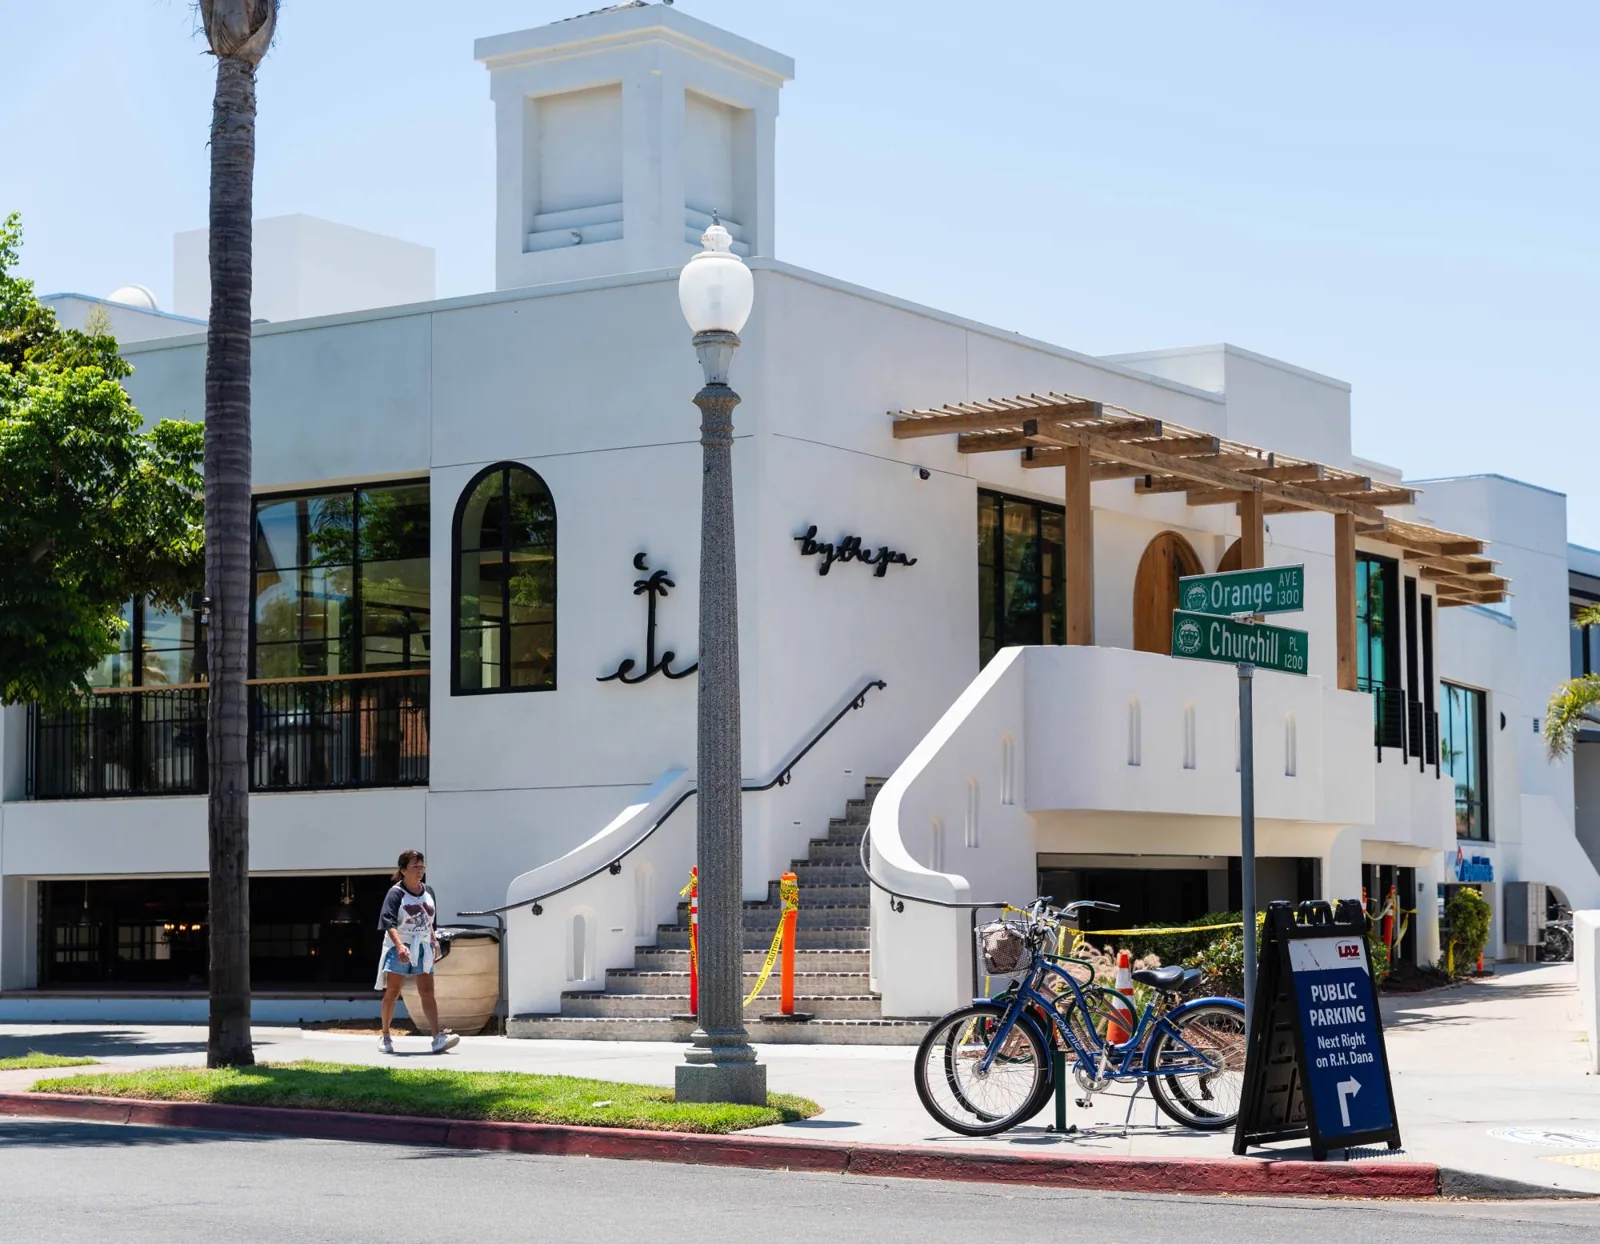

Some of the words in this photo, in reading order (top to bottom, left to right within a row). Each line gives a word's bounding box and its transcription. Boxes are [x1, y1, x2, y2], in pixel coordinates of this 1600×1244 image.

[1279, 571, 1298, 587] AVE
[1211, 580, 1273, 611] Orange
[1276, 589, 1300, 606] 1300
[1209, 621, 1279, 665] Churchill
[1289, 636, 1298, 652] PL
[1284, 653, 1304, 670] 1200
[767, 936, 780, 966] CAUTION
[1338, 945, 1360, 958] LAZ
[1310, 982, 1357, 1002] PUBLIC
[1309, 1005, 1366, 1027] PARKING
[1317, 1035, 1341, 1050] Next
[1341, 1032, 1366, 1049] Right
[1316, 1057, 1329, 1068] on
[1329, 1052, 1349, 1067] R.H.
[1349, 1051, 1374, 1065] Dana
